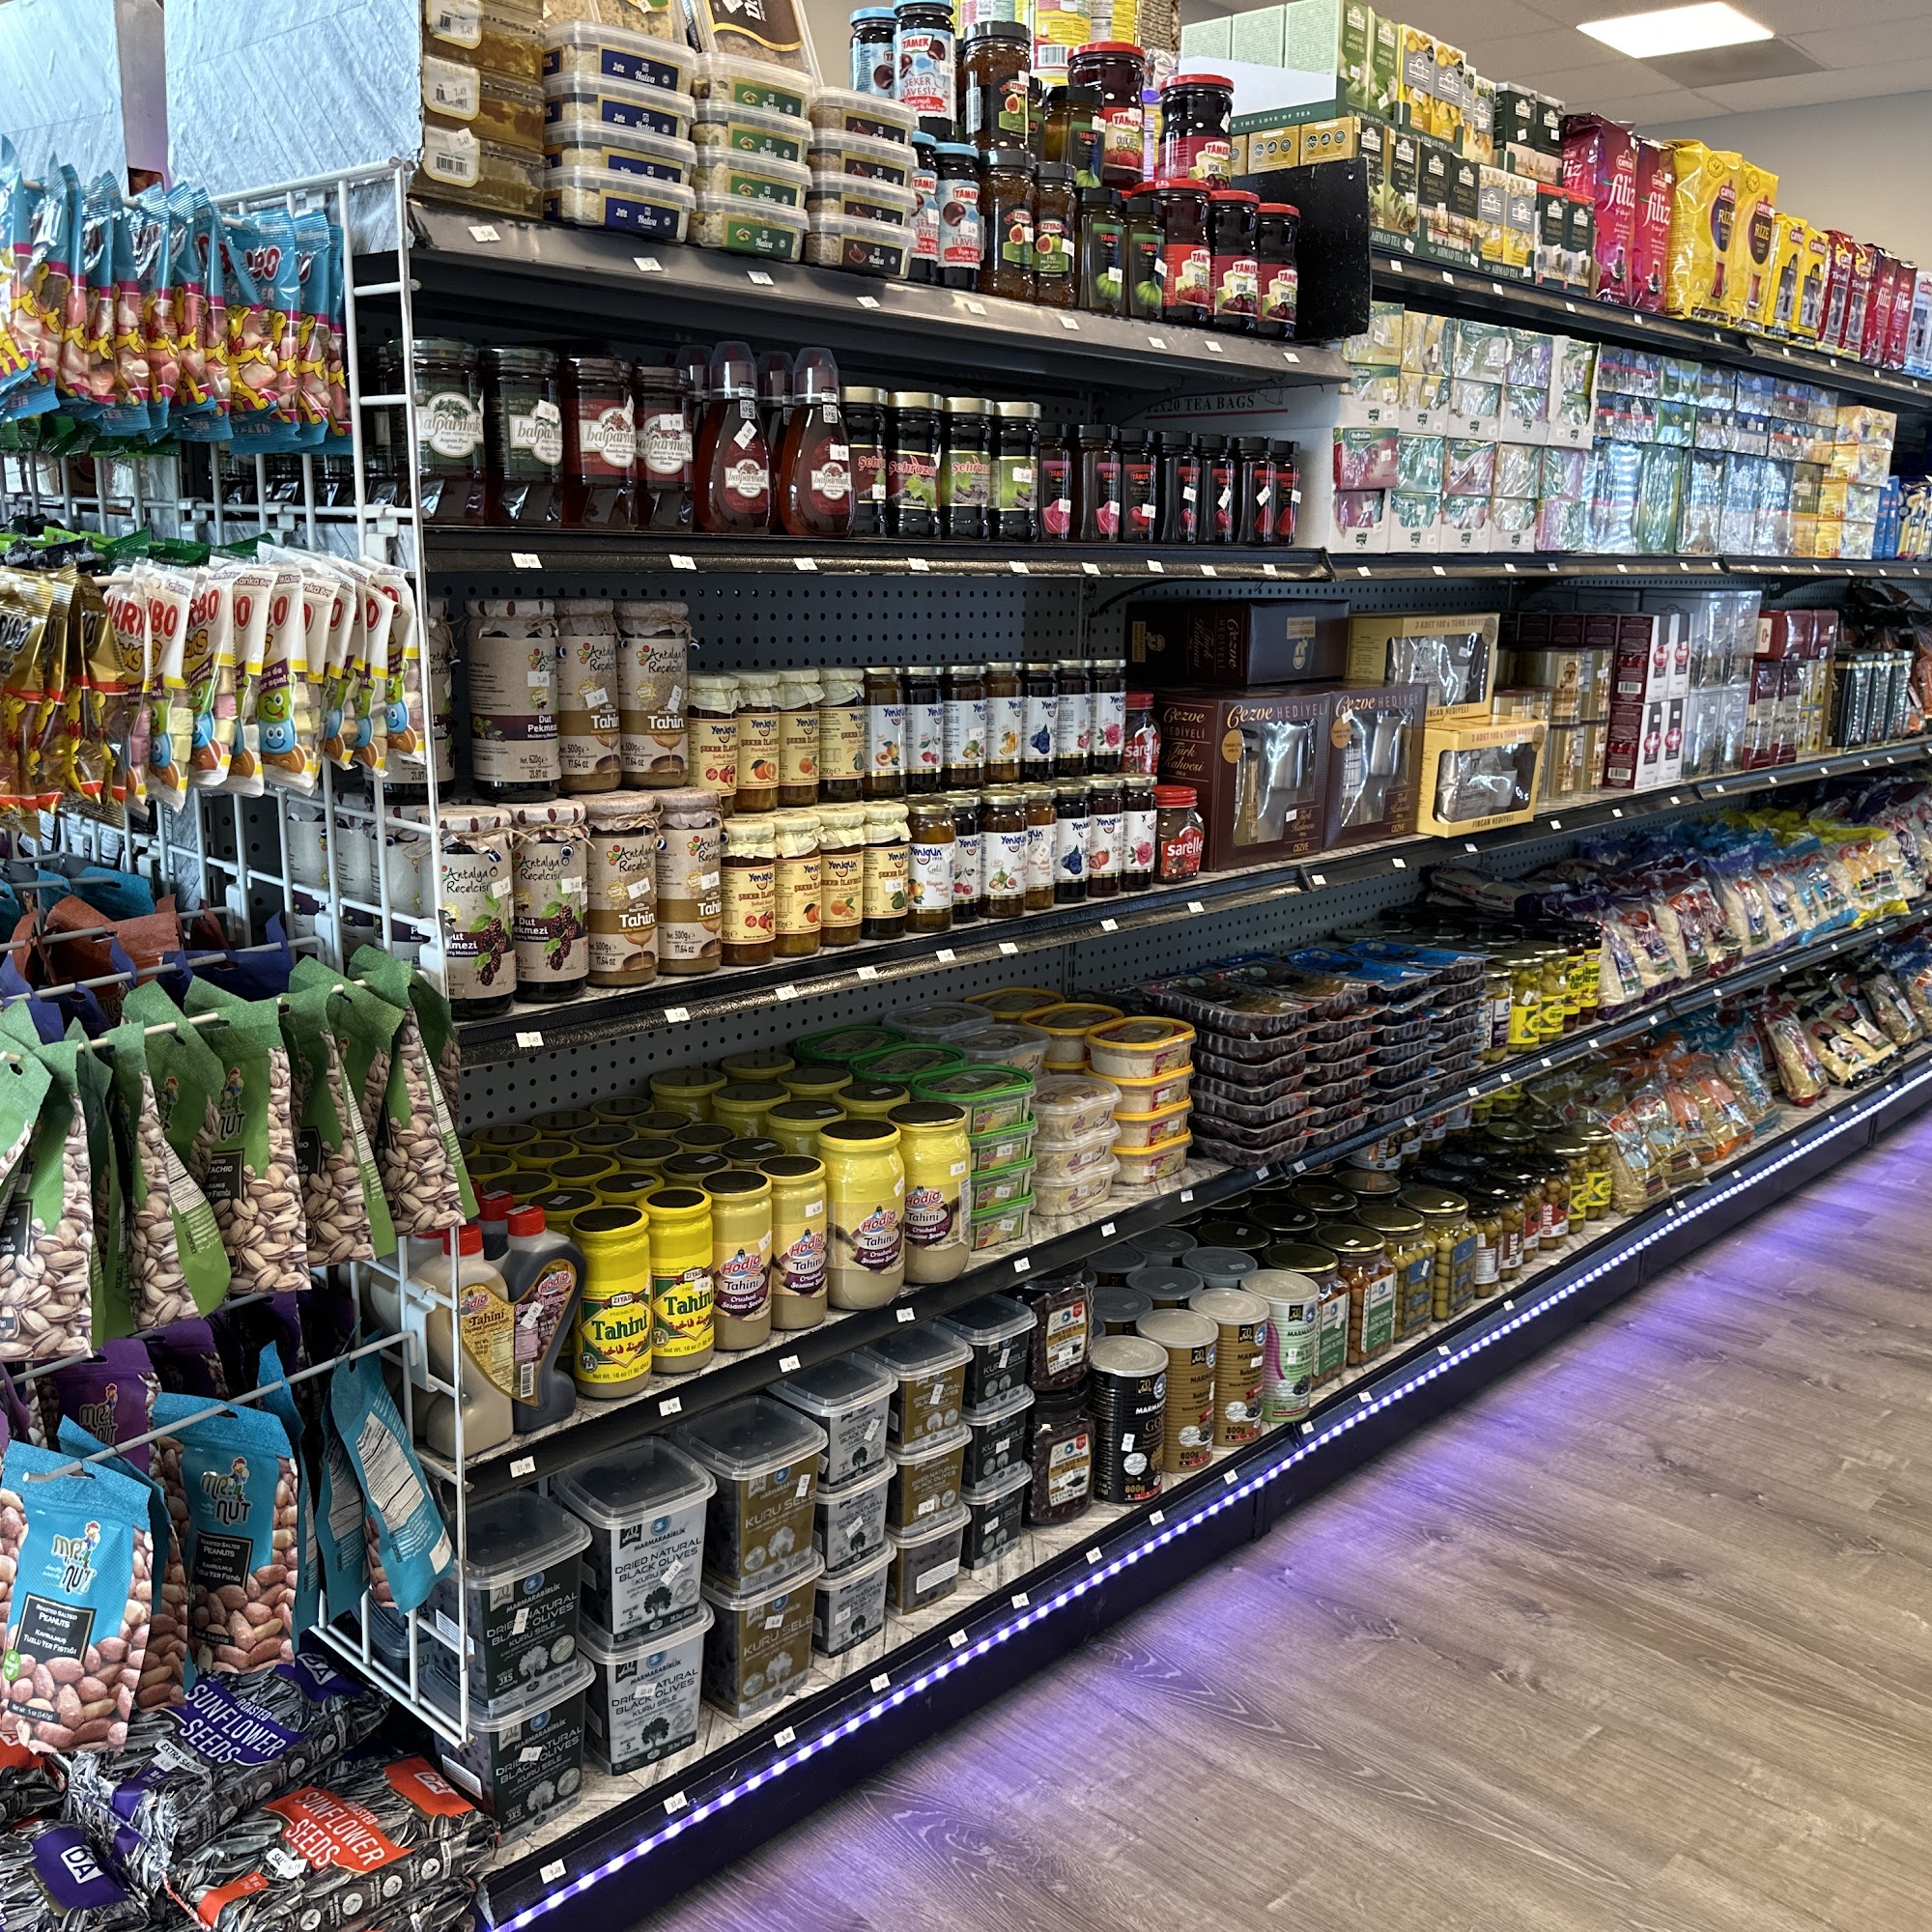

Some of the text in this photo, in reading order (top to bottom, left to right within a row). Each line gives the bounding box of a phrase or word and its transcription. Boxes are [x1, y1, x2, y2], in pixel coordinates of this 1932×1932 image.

[902, 38, 929, 48] TAMEK
[955, 188, 977, 199] TAMEK
[1643, 191, 1670, 227] filiz
[638, 213, 657, 226] Halva
[1371, 231, 1400, 247] AHMAD TEA
[1754, 222, 1770, 240] RİZE
[1436, 247, 1463, 263] AHMAD TEA
[1492, 266, 1519, 277] AHMAD TEA
[1184, 398, 1212, 412] TEA
[1215, 394, 1255, 410] BAGS
[1420, 620, 1434, 629] ADET
[1228, 618, 1239, 670] Cezve
[1227, 701, 1328, 728] Cezve HEDİYELİ
[1335, 695, 1377, 718] Cezve
[538, 715, 552, 724] Dut
[591, 713, 619, 728] Tahin
[647, 715, 684, 729] Tahin
[1163, 707, 1206, 724] Cezve
[1475, 733, 1489, 742] ADET
[567, 743, 582, 754] 500g
[1123, 741, 1160, 757] sarelle
[1169, 741, 1195, 758] Türk
[1162, 755, 1205, 773] Kahvesi
[1167, 839, 1203, 857] sarelle
[1293, 841, 1309, 853] CEZVE
[519, 856, 560, 872] Antalya
[446, 866, 488, 885] Antalya
[519, 917, 535, 926] Dut
[619, 913, 655, 928] Tahin
[207, 1164, 233, 1174] TACHIO
[905, 1190, 941, 1206] Hodja
[862, 1210, 896, 1232] Hodja
[906, 1211, 939, 1222] Tahini
[1543, 1204, 1553, 1236] OLIVES
[905, 1229, 947, 1239] Sesame Seeds
[911, 1226, 937, 1235] Crushed
[790, 1233, 823, 1256] Hodja
[864, 1235, 895, 1247] Tahini
[1509, 1233, 1519, 1266] OLIVES
[861, 1256, 884, 1264] Sesame
[869, 1249, 893, 1259] Crushed
[721, 1254, 761, 1274] Hodja
[541, 1272, 569, 1292] Hodja
[686, 1269, 701, 1279] ZIYAD
[724, 1278, 759, 1291] Tahini
[612, 1295, 632, 1304] ZIYAD
[664, 1284, 713, 1316] Tahini
[721, 1296, 765, 1310] Sesame Seeds
[730, 1293, 757, 1303] Crushed
[469, 1309, 504, 1326] Tahini
[591, 1310, 647, 1340] Tahini
[1226, 1426, 1245, 1435] 800g
[1180, 1451, 1199, 1461] 800g
[1125, 1484, 1145, 1493] 800g
[745, 1489, 815, 1529] KURU SELE
[614, 1537, 701, 1575] DRIED NATURAL
[618, 1546, 698, 1583] BLACK OLIVES
[634, 1572, 658, 1586] KURU
[532, 1602, 574, 1627] OLIVES
[508, 1631, 533, 1648] KURU
[533, 1620, 556, 1636] SELE
[744, 1615, 812, 1658] KURU SELE
[498, 1673, 514, 1687] 3XS
[615, 1678, 695, 1716] BLACK OLIVES
[236, 1698, 271, 1721] ROASTED
[632, 1694, 677, 1718] KURU SELE
[185, 1684, 287, 1757] SUNFLOWER
[180, 1719, 242, 1765] SEEDS
[159, 1742, 184, 1762] EXTRA
[539, 1737, 580, 1769] OLIVES
[517, 1756, 562, 1785] KURU SELE
[343, 1800, 379, 1825] ROASTED
[506, 1808, 522, 1820] 3XS
[296, 1791, 385, 1866] SUNFLOWER
[286, 1819, 341, 1867] SEEDS
